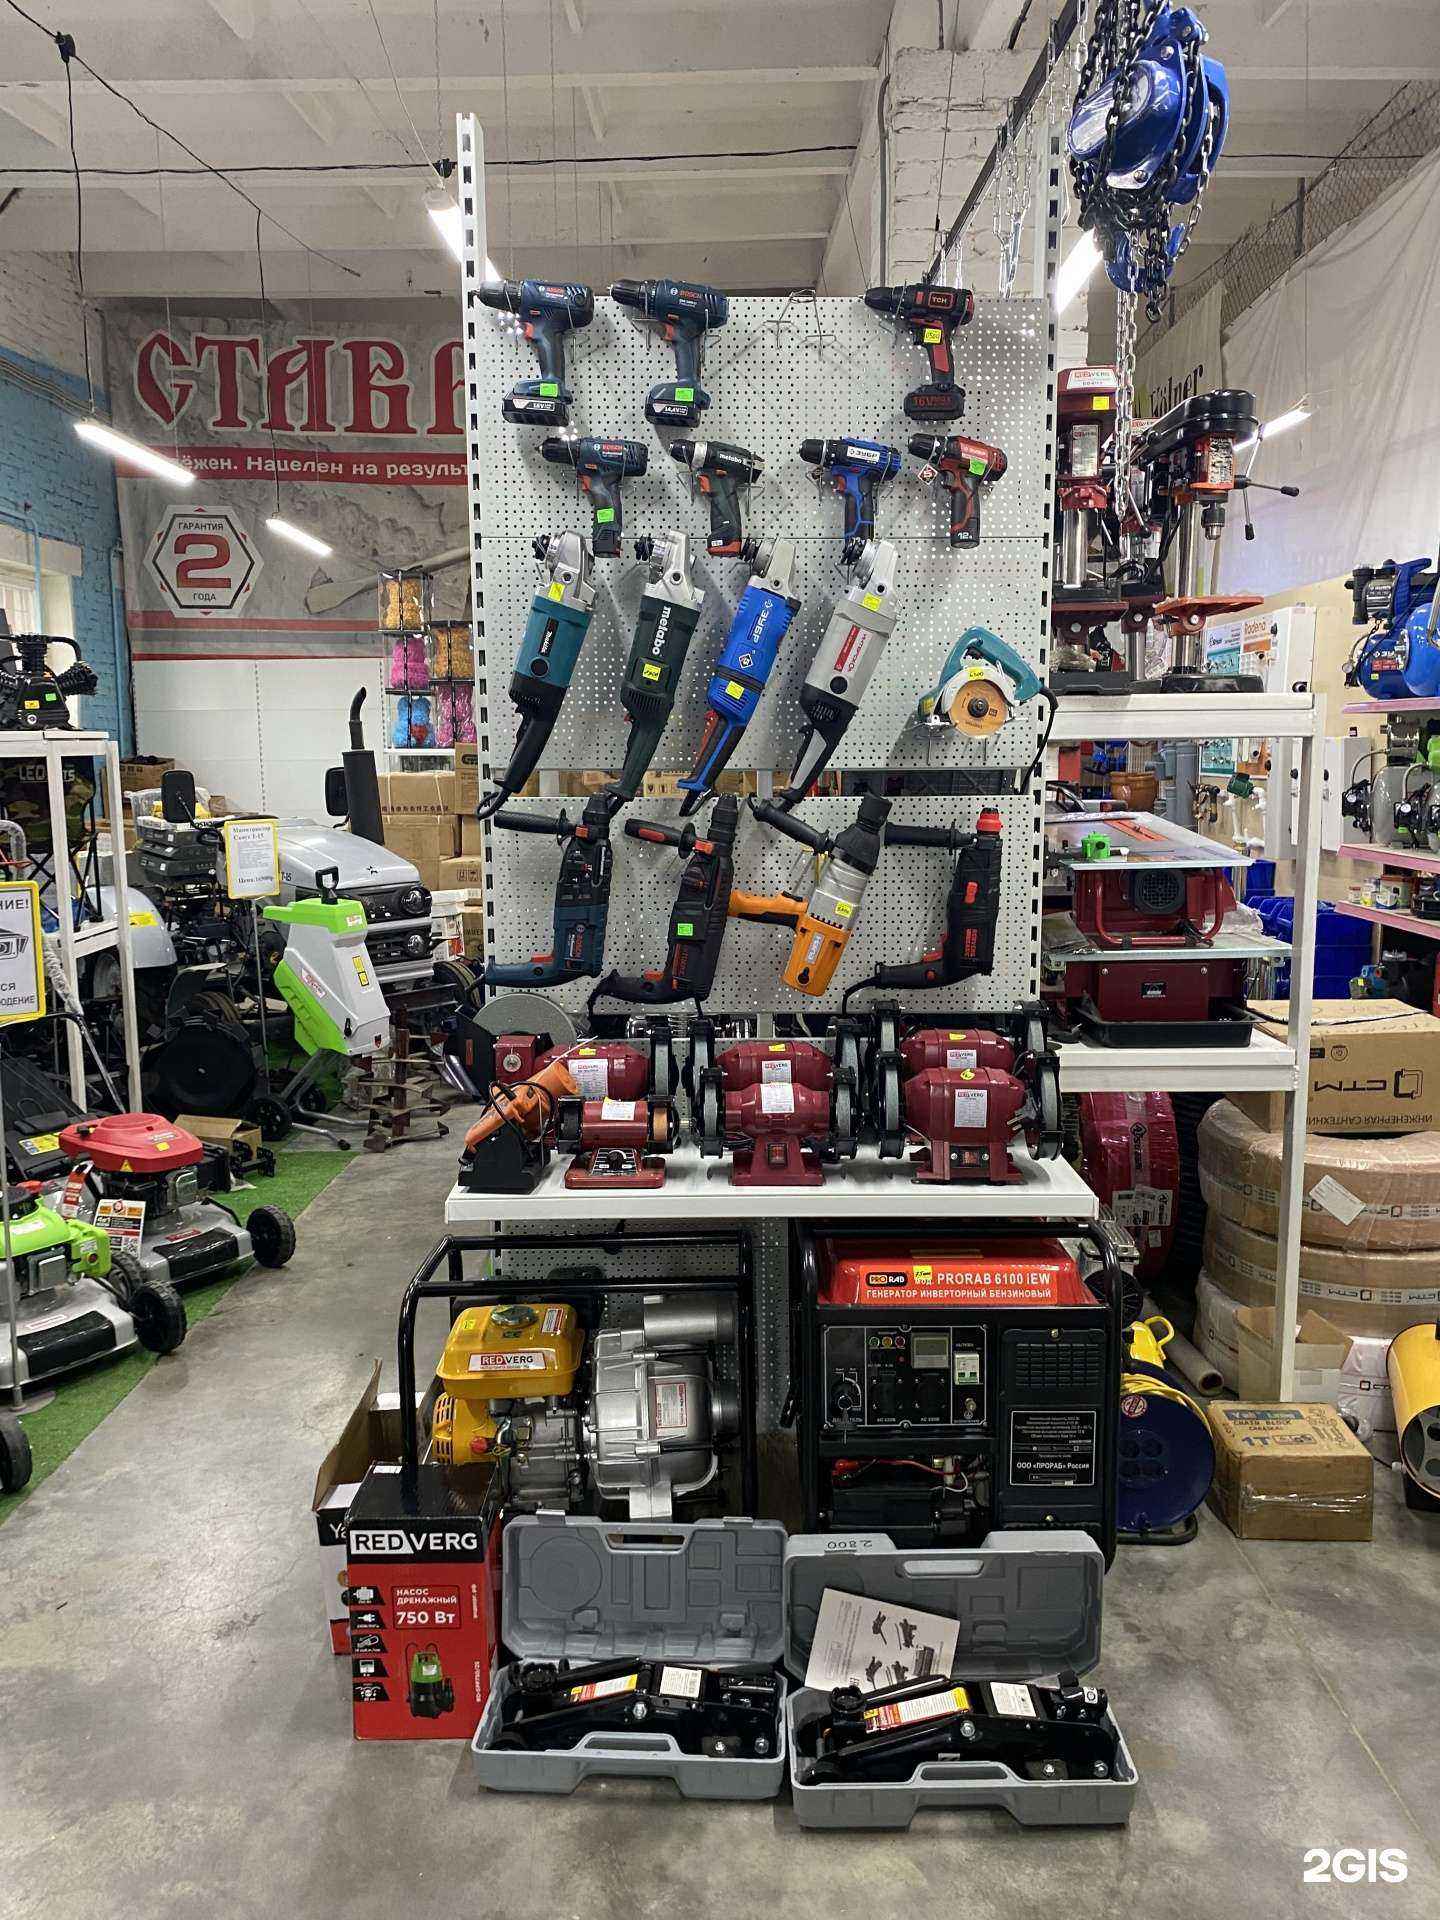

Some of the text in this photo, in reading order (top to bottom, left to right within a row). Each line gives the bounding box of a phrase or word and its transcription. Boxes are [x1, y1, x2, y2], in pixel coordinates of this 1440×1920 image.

[720, 453, 742, 464] metabo
[246, 456, 343, 474] Нацелен
[352, 462, 378, 476] на
[178, 522, 224, 531] ГАРАНТИЯ
[174, 533, 231, 588] 2
[193, 593, 216, 602] ГОДА
[652, 605, 672, 656] metabo
[753, 610, 769, 643] ЗУБР
[1308, 1114, 1433, 1126] ИНЖЕНЕРНАЯ САНТЕХНИ
[937, 1273, 991, 1284] PRORAB
[995, 1273, 1023, 1284] 6100
[866, 1287, 1051, 1298] ГЕНЕРАТОР ИНВЕРТОРНЫЙ БЕНЗИНОВЫЙ
[396, 1588, 429, 1596] НАСОС
[396, 1595, 457, 1605] ДРЕНАЖНЫЙ
[396, 1611, 455, 1624] 750 Вт
